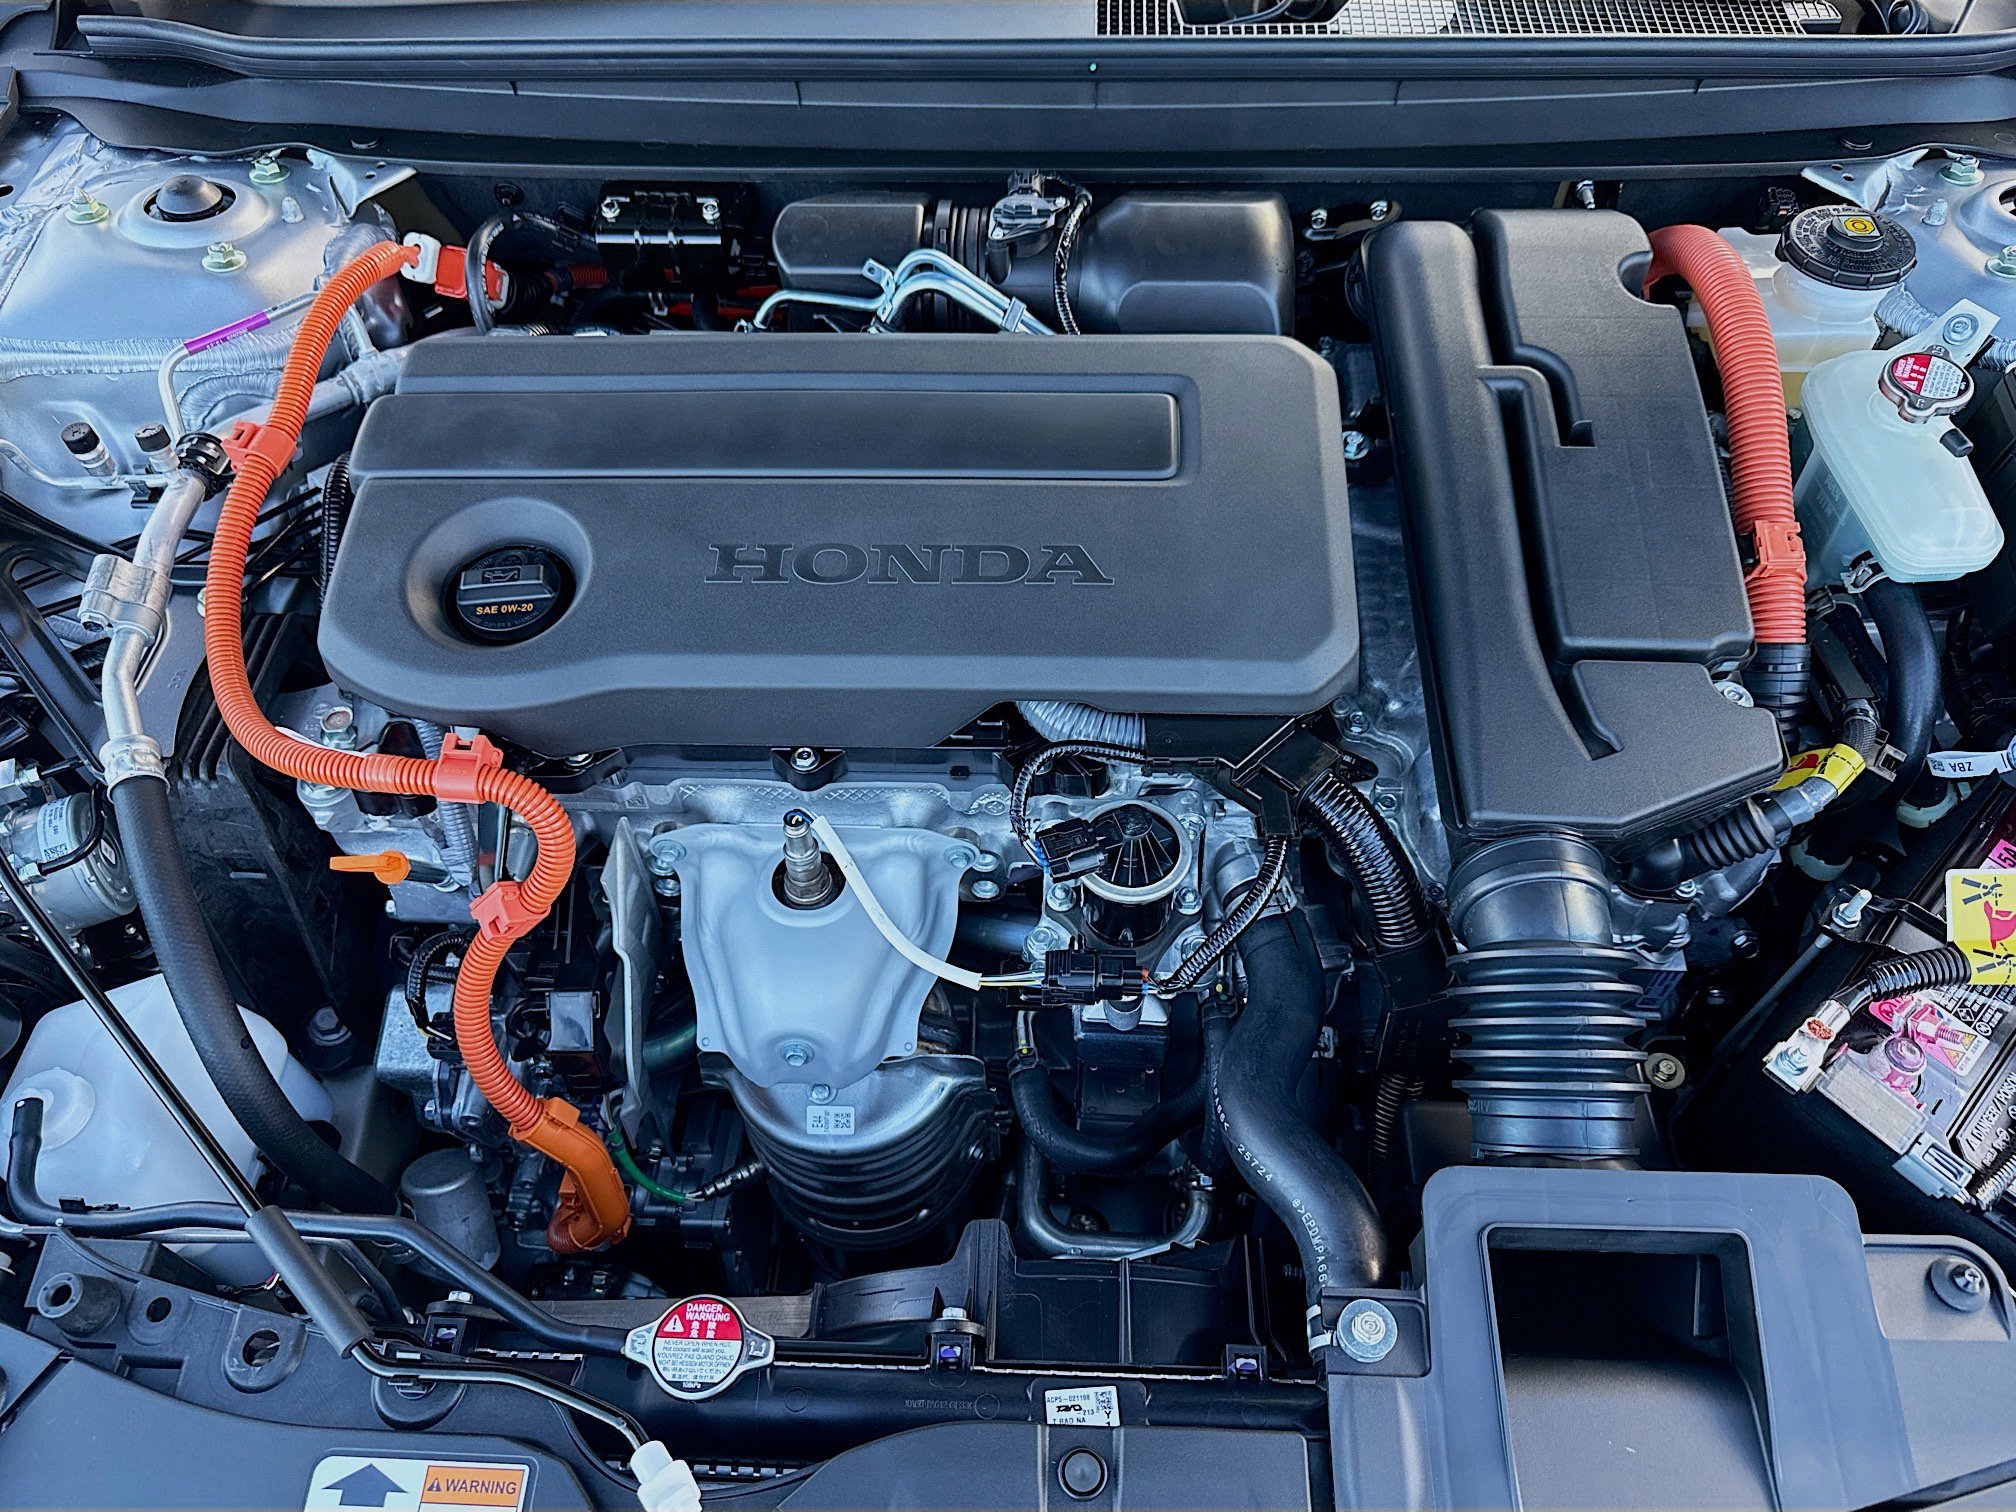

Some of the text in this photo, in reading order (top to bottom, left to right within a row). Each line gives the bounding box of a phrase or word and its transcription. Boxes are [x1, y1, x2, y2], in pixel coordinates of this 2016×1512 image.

[704, 543, 1116, 585] HONDA
[476, 603, 534, 616] SAE 0W-20
[1948, 761, 1974, 773] ZBA
[686, 1303, 723, 1313] DANGER
[685, 1311, 731, 1322] WARNUNG
[1104, 1410, 1112, 1419] Y
[445, 1478, 517, 1495] WARNING
